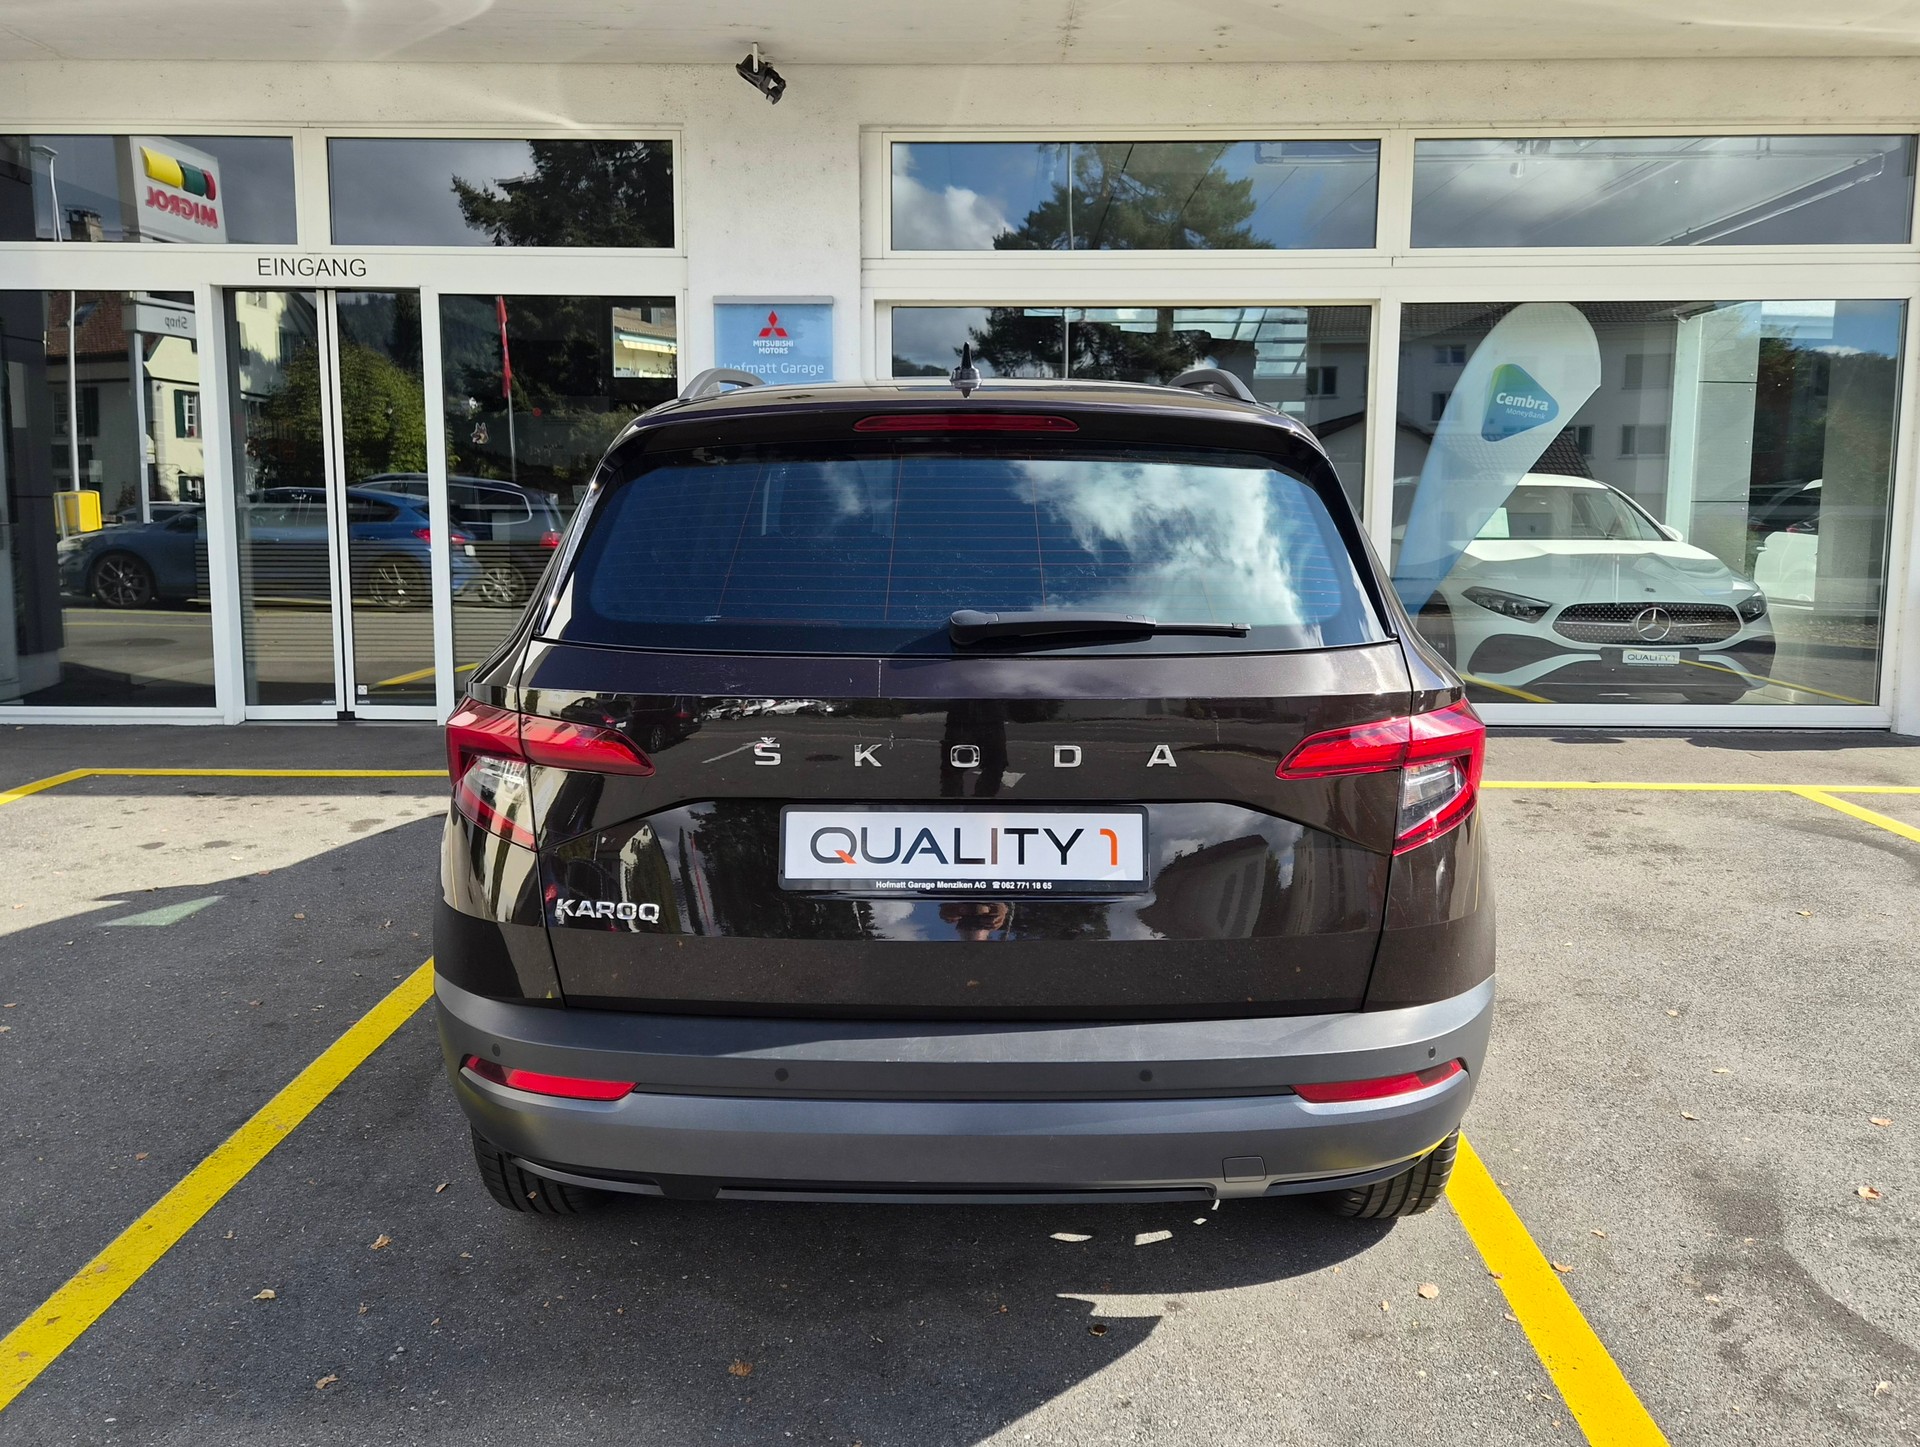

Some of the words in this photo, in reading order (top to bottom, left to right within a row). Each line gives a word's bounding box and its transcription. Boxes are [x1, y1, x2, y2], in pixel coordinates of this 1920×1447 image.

[257, 257, 367, 277] EINGANG
[780, 362, 825, 376] Garage
[1496, 392, 1549, 411] Cembra
[1506, 408, 1546, 419] MoneyBank
[754, 737, 1177, 768] ŠKODA
[810, 826, 1085, 865] QUALITY
[1099, 828, 1119, 866] 1
[876, 881, 906, 889] Hofmatt
[908, 881, 935, 890] Garage
[937, 881, 973, 889] Menziken
[974, 881, 987, 889] AG
[1001, 882, 1015, 890] 062
[1017, 882, 1030, 890] 771
[1032, 882, 1041, 890] 18
[1043, 882, 1052, 890] 65
[555, 899, 660, 924] KAROQ
